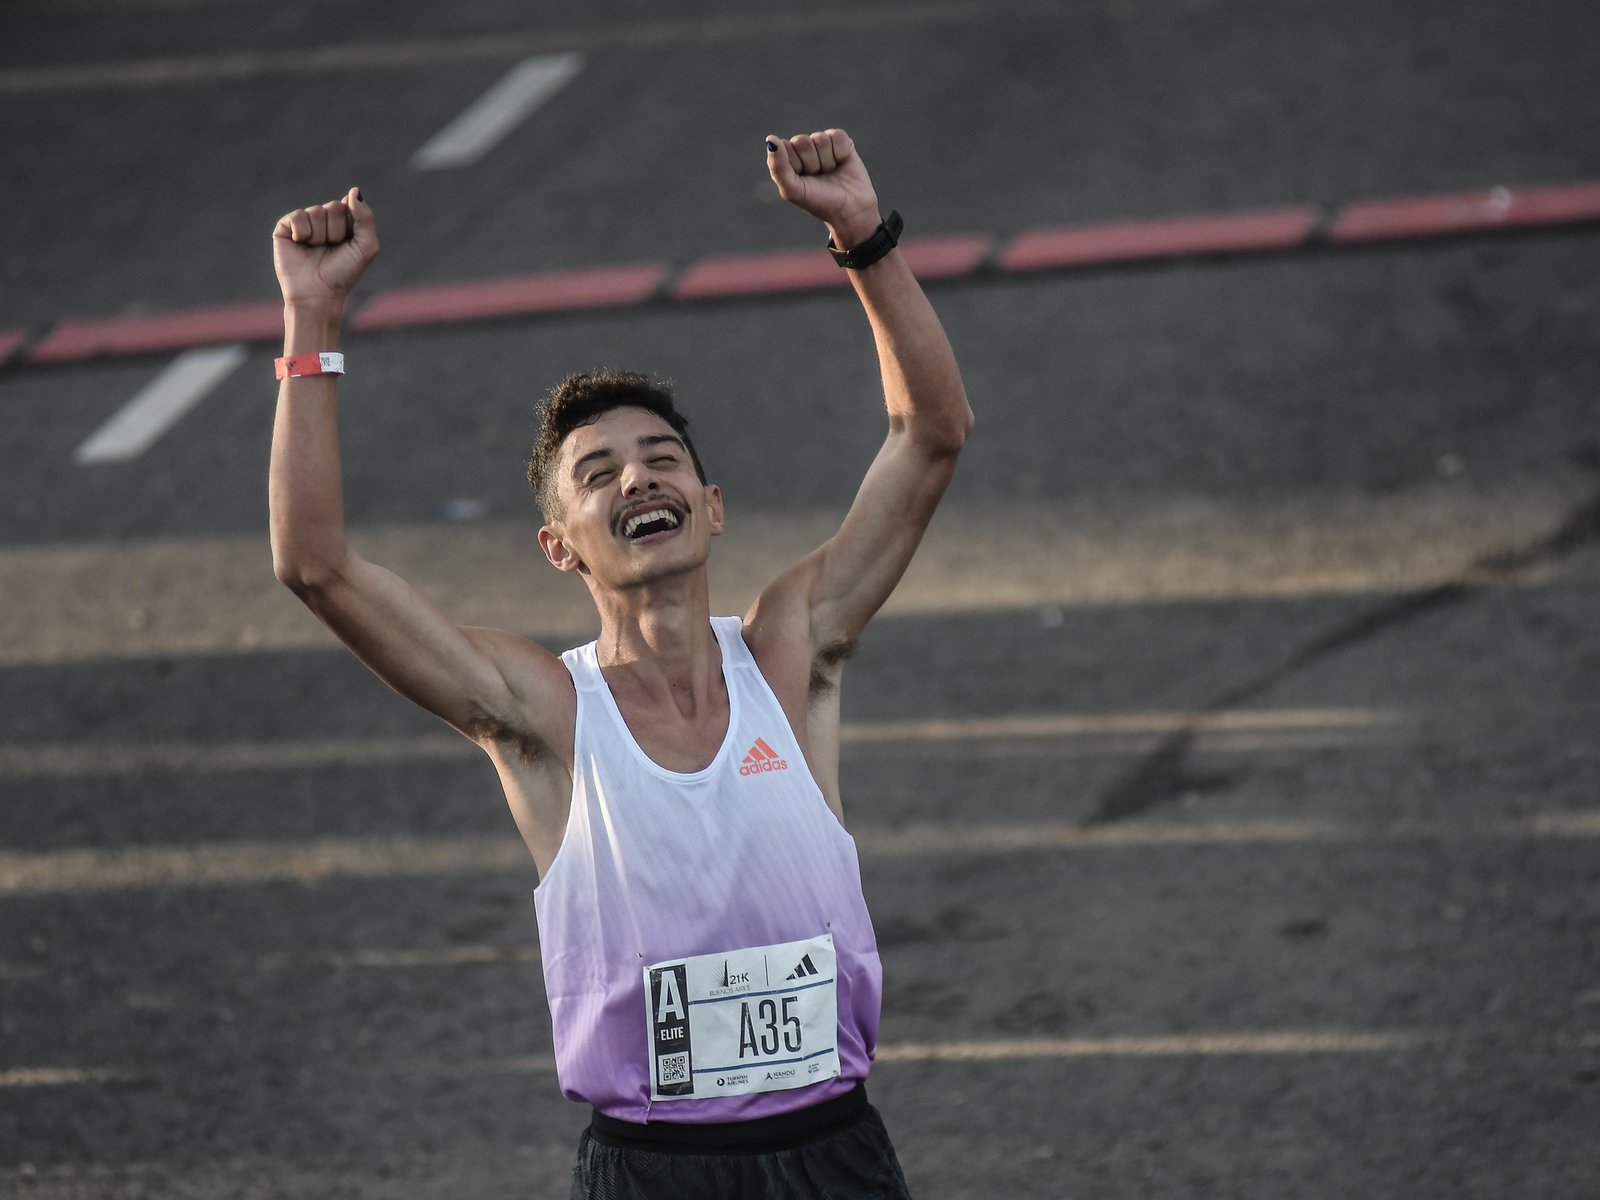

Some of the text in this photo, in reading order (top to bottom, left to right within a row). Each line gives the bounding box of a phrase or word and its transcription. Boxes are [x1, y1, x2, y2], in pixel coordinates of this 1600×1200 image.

[739, 759, 787, 776] adidas
[730, 973, 750, 985] 21K
[658, 970, 685, 1023] A
[710, 984, 750, 996] BUENOS AIRES
[660, 1026, 685, 1041] ELITE
[740, 997, 802, 1059] A35
